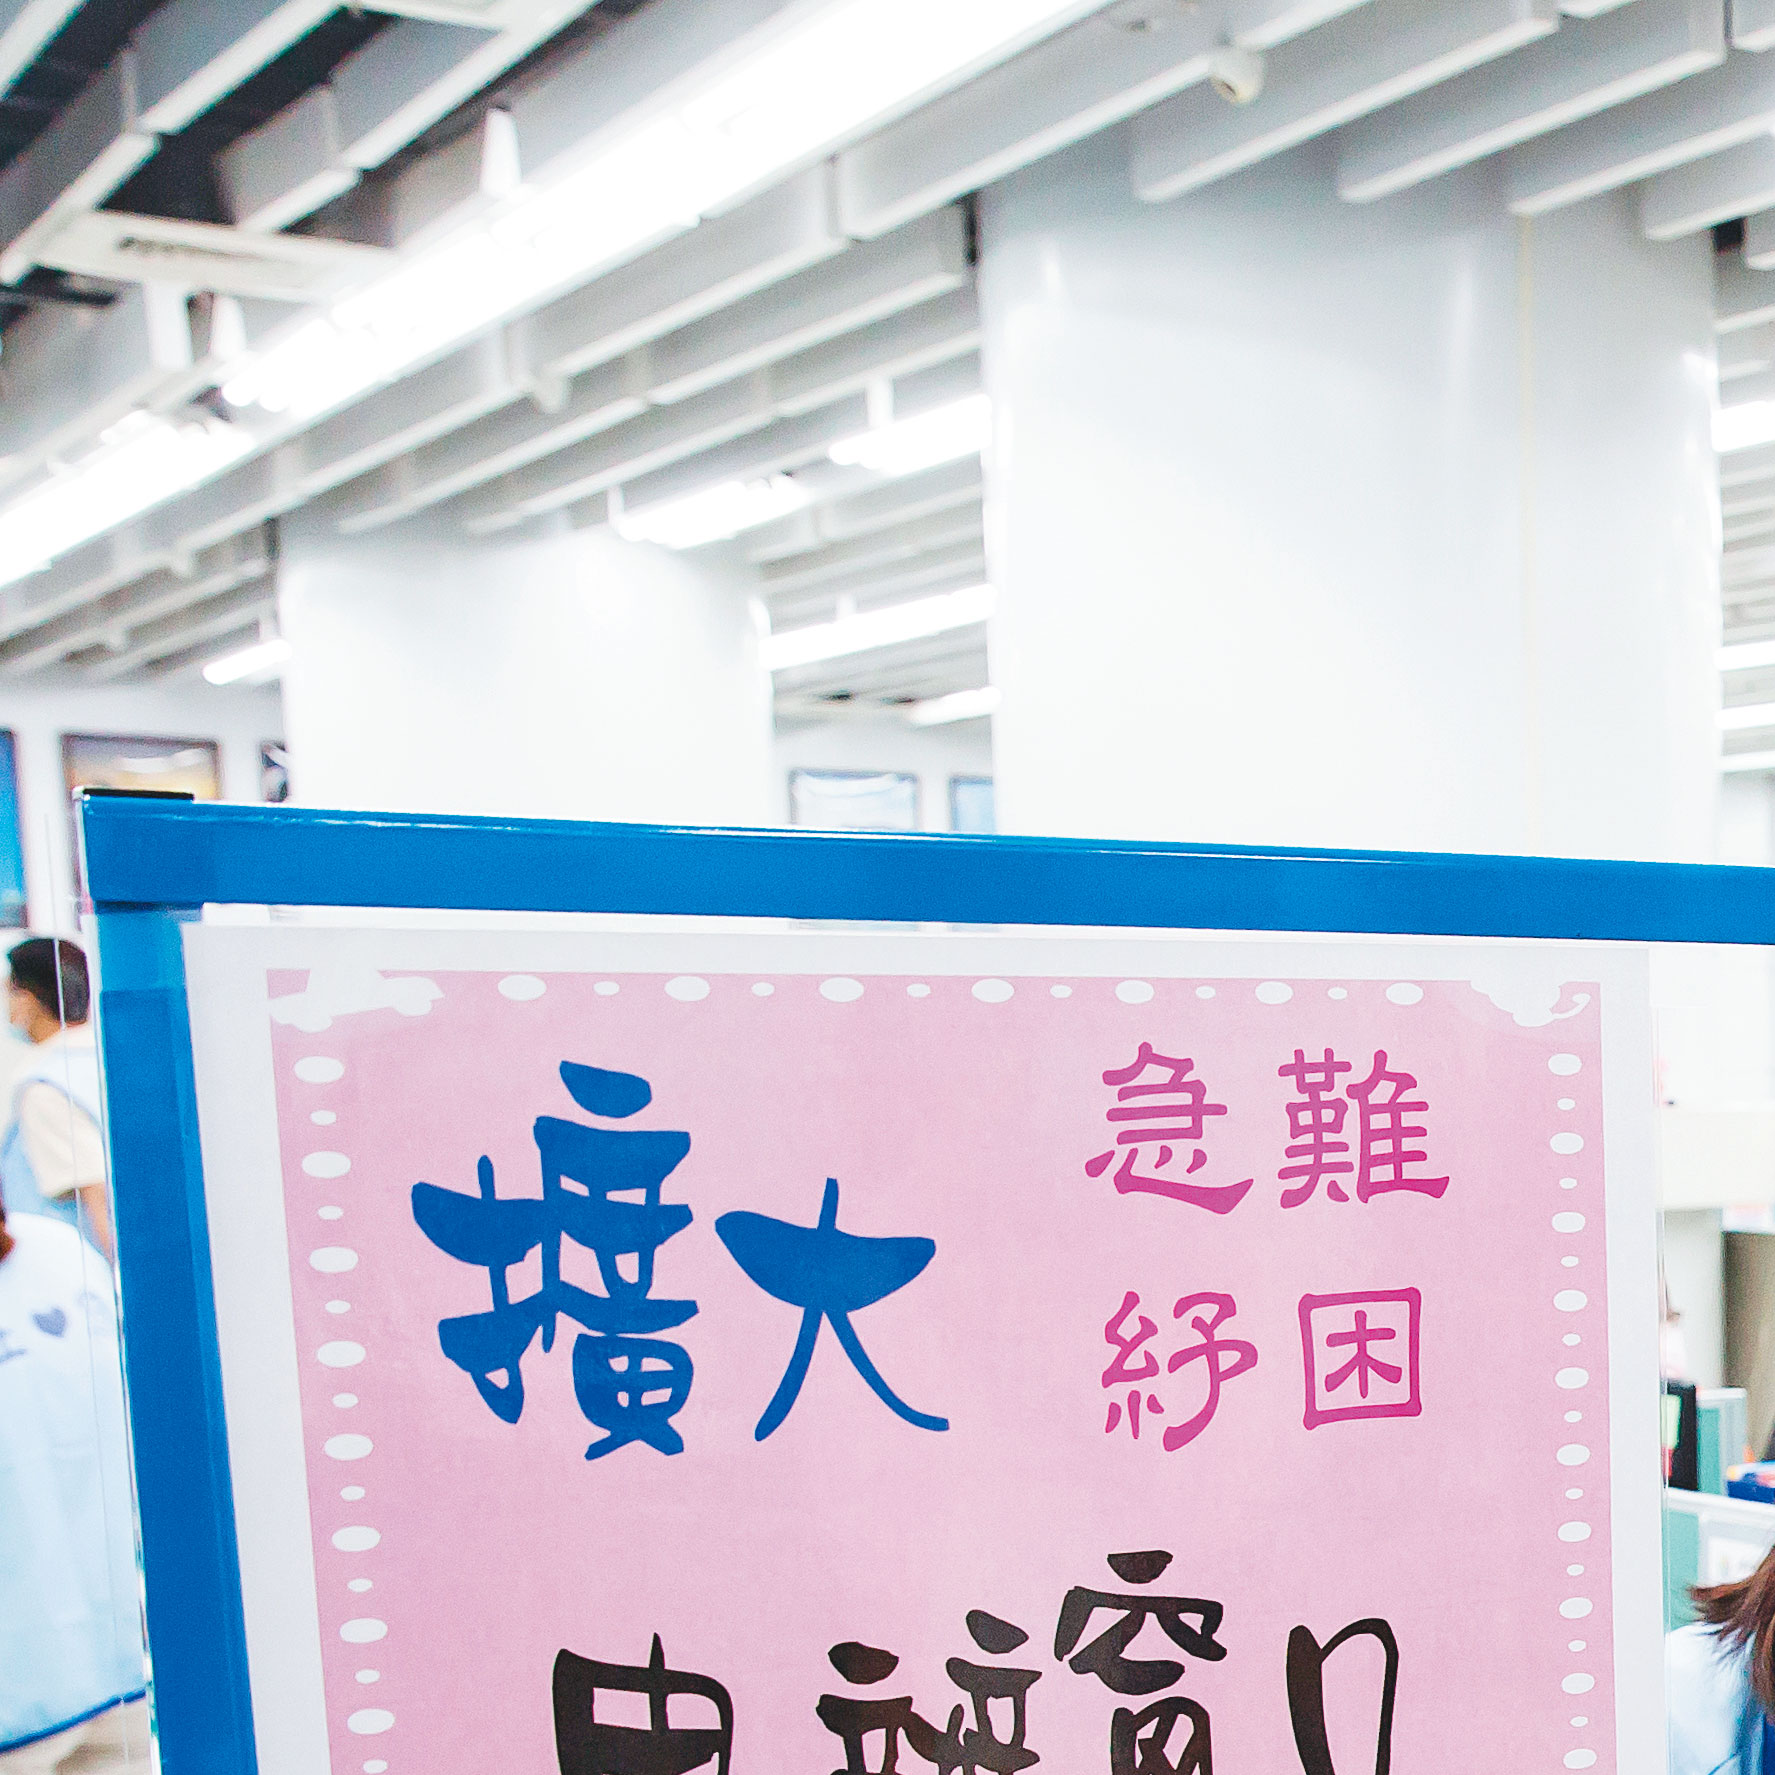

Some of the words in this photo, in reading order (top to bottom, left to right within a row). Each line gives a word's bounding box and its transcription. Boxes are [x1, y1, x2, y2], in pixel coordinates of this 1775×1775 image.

[1085, 1042, 1449, 1214] 急難
[412, 1061, 948, 1460] 擴大
[1102, 1287, 1422, 1452] 紓困
